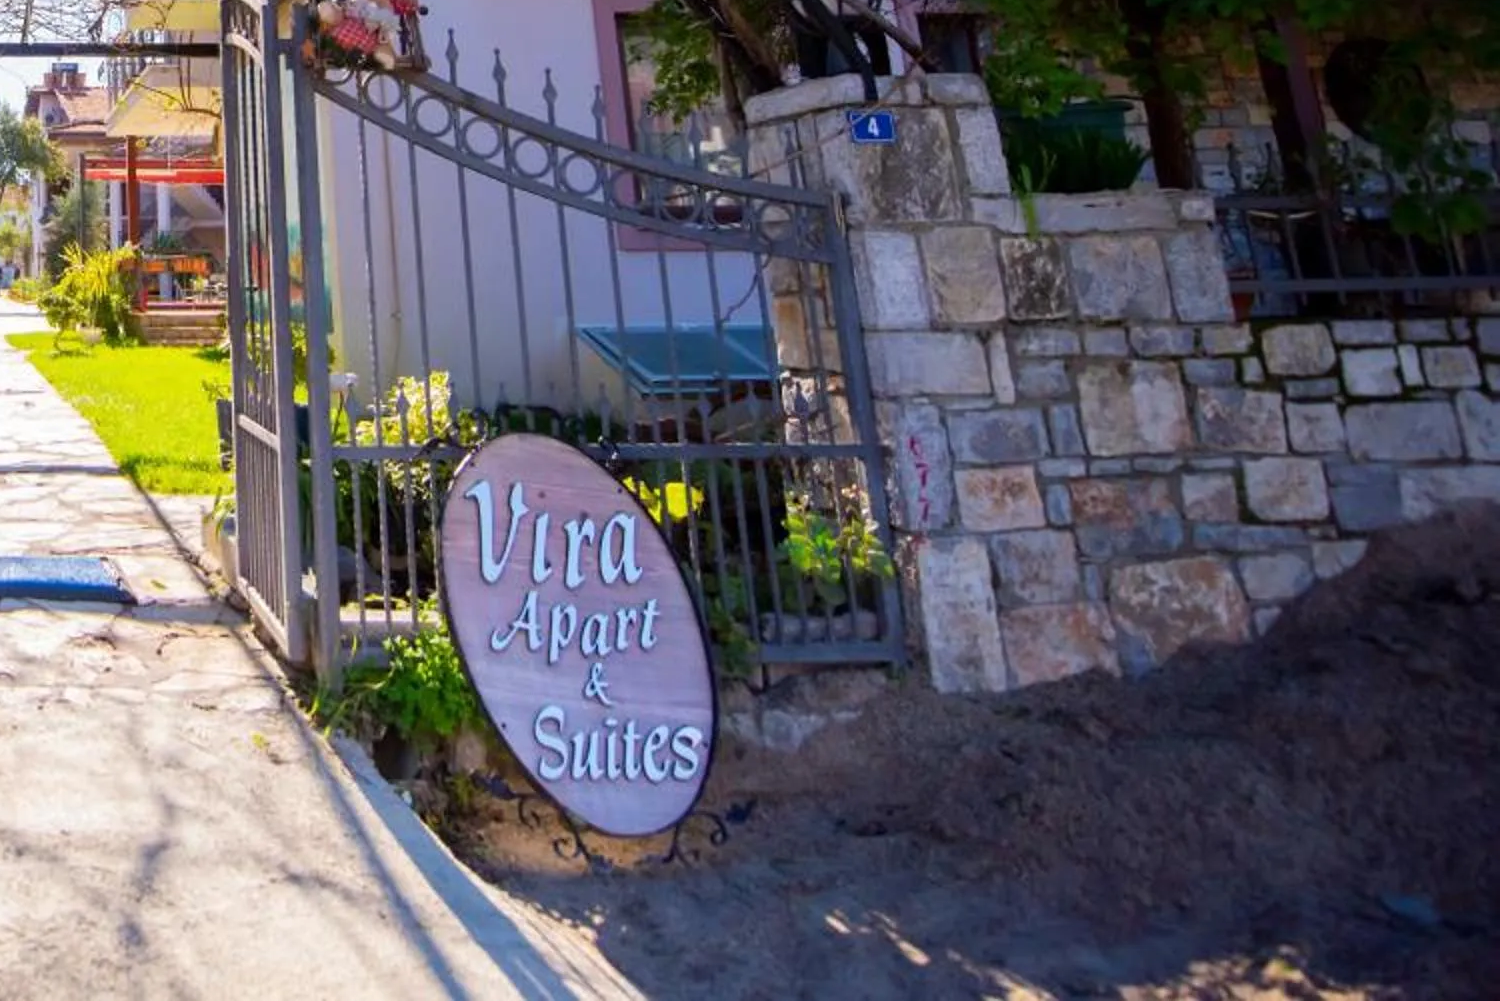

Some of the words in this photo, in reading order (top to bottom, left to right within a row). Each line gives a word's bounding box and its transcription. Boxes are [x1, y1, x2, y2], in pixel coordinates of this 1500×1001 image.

[867, 116, 879, 137] 4
[490, 589, 661, 665] Apart
[582, 661, 617, 707] &
[534, 703, 703, 782] Suites
